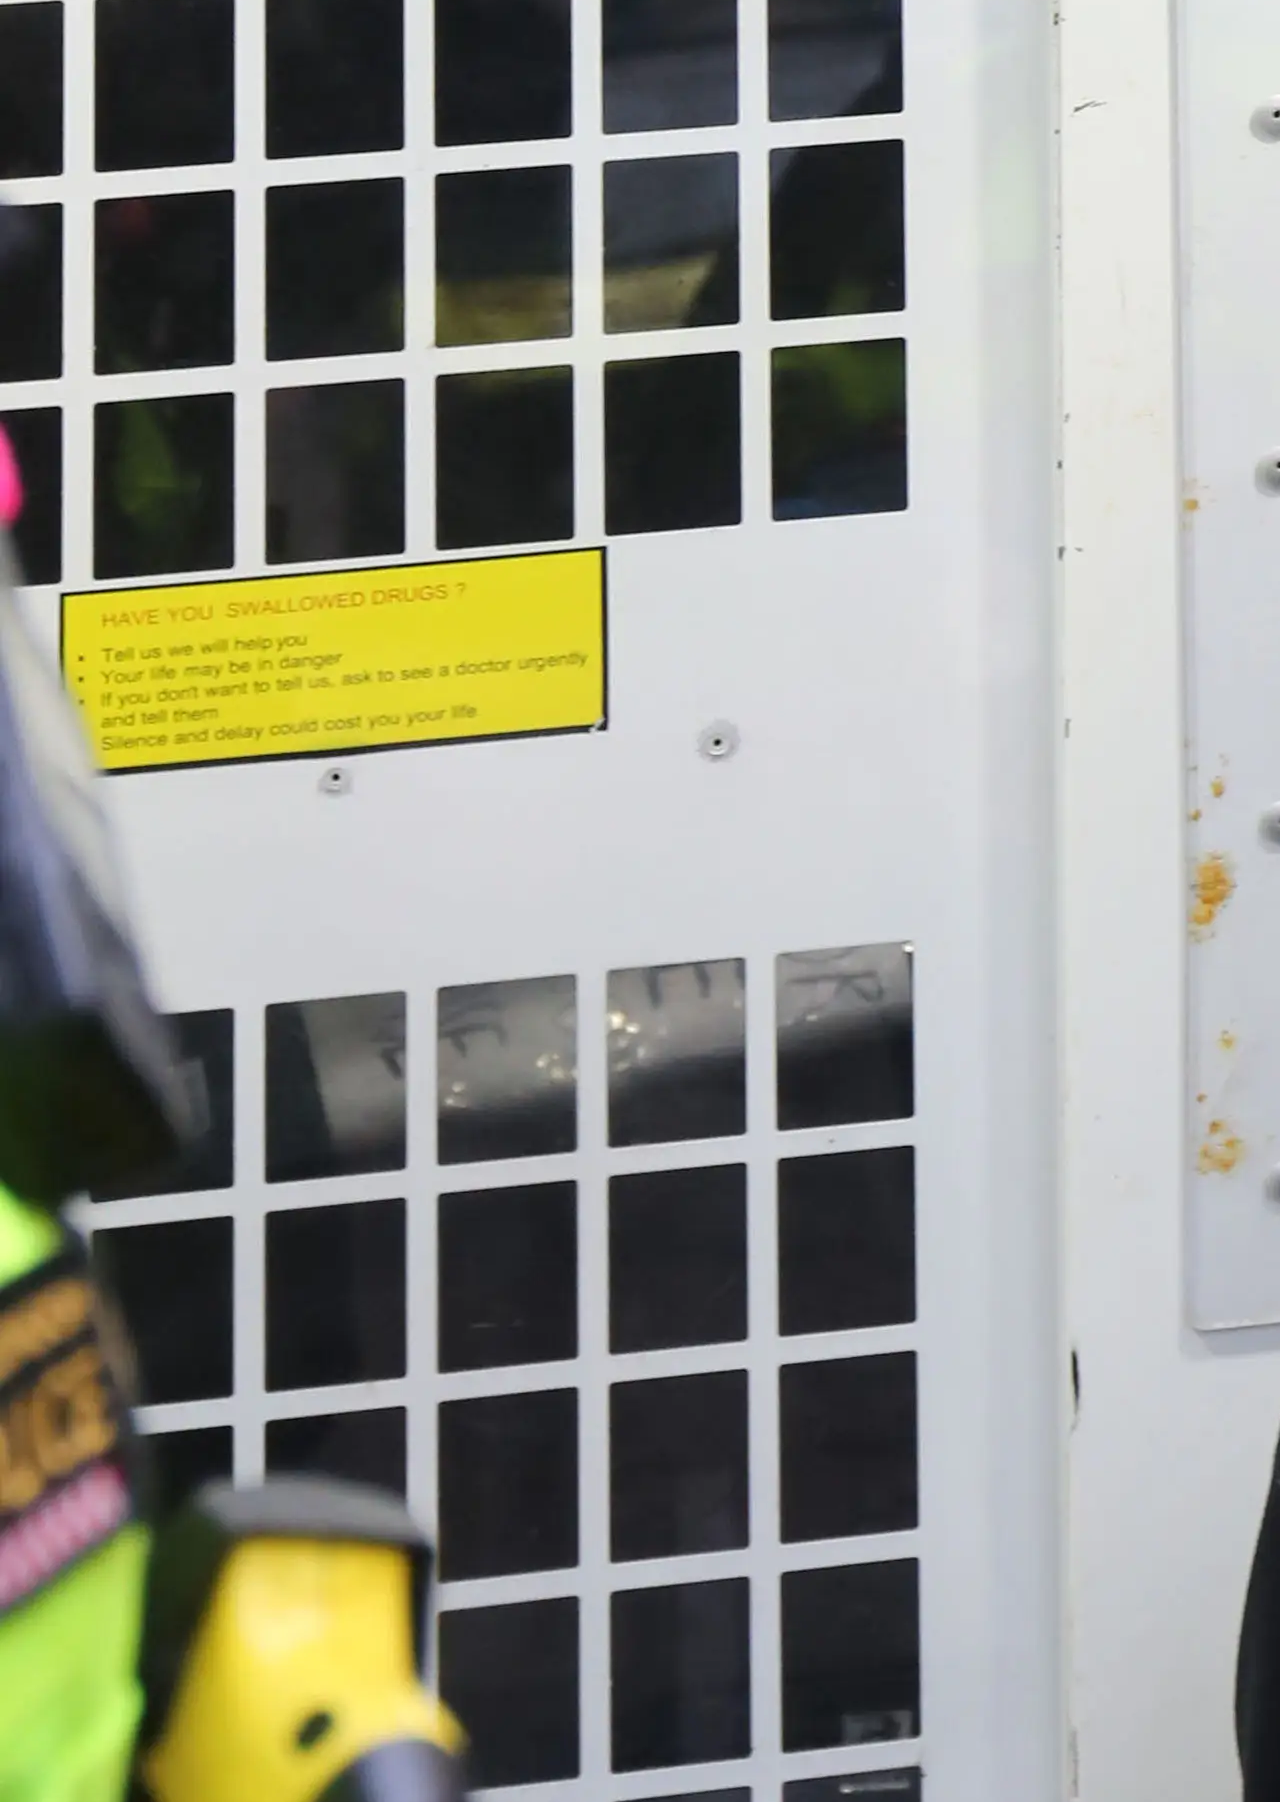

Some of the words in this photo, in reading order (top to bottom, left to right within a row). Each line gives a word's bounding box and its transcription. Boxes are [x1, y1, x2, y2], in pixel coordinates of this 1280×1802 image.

[100, 609, 160, 627] HAVE
[167, 605, 214, 622] YOU
[226, 591, 365, 618] SWALLOWED
[371, 584, 448, 605] DRUGS
[101, 647, 135, 662] Tell
[140, 647, 162, 659] us
[168, 644, 193, 657] we
[201, 639, 228, 654] will
[235, 635, 273, 651] help
[277, 635, 308, 652] you
[100, 669, 144, 684] Your
[150, 665, 176, 680] life
[184, 664, 222, 679] may
[228, 659, 251, 674] be
[258, 657, 273, 671] in
[280, 653, 343, 670] danger
[101, 692, 113, 707] If
[118, 694, 151, 709] you
[205, 682, 247, 697] want
[253, 681, 271, 694] to
[276, 676, 302, 691] tell
[342, 669, 371, 686] ask
[377, 669, 394, 682] to
[400, 667, 433, 680] see
[439, 665, 449, 677] a
[455, 659, 512, 675] doctor
[518, 651, 588, 672] urgently
[101, 713, 135, 728] and
[141, 709, 167, 725] tell
[173, 707, 218, 723] them
[102, 734, 168, 751] Silence
[174, 729, 209, 744] and
[214, 724, 264, 741] delay
[269, 720, 318, 736] could
[324, 715, 361, 731] cost
[368, 714, 400, 730] you
[406, 709, 447, 727] your
[451, 704, 477, 719] life
